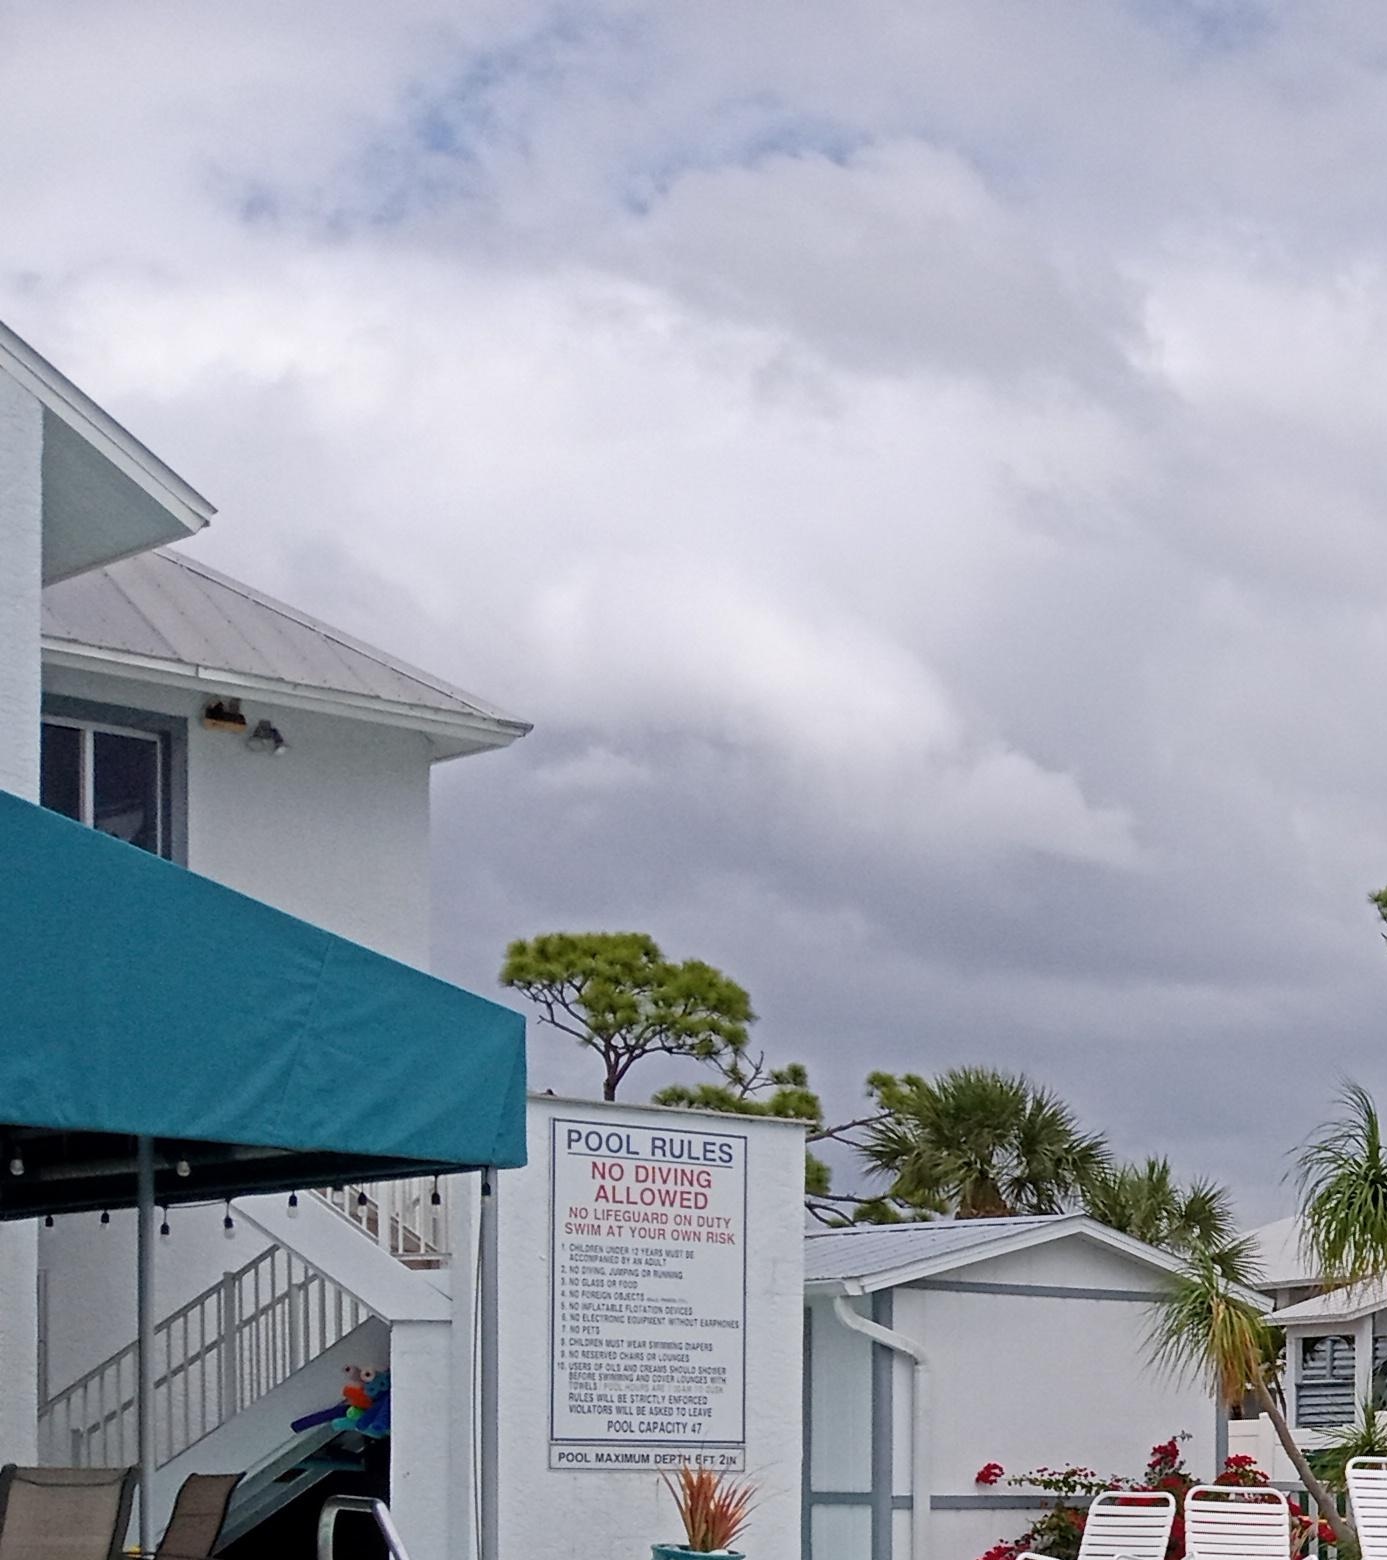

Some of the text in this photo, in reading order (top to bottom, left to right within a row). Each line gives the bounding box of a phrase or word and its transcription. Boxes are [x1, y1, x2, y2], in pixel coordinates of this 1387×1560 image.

[568, 1129, 733, 1163] POOL RULES
[592, 1161, 712, 1188] NO DIVING
[595, 1185, 708, 1210] ALLOWED
[569, 1207, 731, 1228] NO LIFEGUARD ON DUTY
[565, 1223, 735, 1244] SWIM AT YOUR OWN RISK
[569, 1244, 603, 1254] CHILDREN
[606, 1246, 628, 1255] UNDER
[641, 1249, 663, 1257] YEARS
[665, 1250, 684, 1258] MUST
[686, 1251, 694, 1259] BE
[569, 1254, 619, 1264] ACCOMPANIED
[645, 1258, 666, 1266] ADULT
[569, 1266, 579, 1274] NO
[609, 1269, 639, 1277] JUMPING
[569, 1278, 579, 1286] NO
[581, 1279, 604, 1287] GLASS
[607, 1280, 616, 1288] OR
[581, 1291, 612, 1300] FOREIGN
[614, 1293, 645, 1301] OBJECTS
[581, 1303, 623, 1313] INFLATABLE
[625, 1305, 663, 1314] FLOTATION
[665, 1307, 692, 1315] DEVICES
[569, 1314, 579, 1322] NO
[582, 1314, 625, 1324] ELECTRONIC
[628, 1316, 666, 1325] EQUIPMENT
[668, 1318, 697, 1327] WITHOUT
[700, 1320, 739, 1329] EARPHONES
[583, 1326, 599, 1334] PETS
[569, 1338, 602, 1347] CHILDREN
[605, 1340, 624, 1348] MUST
[627, 1341, 646, 1349] WEAR
[649, 1341, 682, 1350] SWIMMING
[685, 1343, 712, 1351] DIAPERS
[581, 1351, 617, 1360] RESERVED
[620, 1352, 643, 1361] CHAIRS
[647, 1353, 656, 1361] OR
[659, 1354, 689, 1362] LOUNGES
[569, 1362, 591, 1371] USERS
[606, 1364, 620, 1372] OILS
[623, 1364, 637, 1372] AND
[640, 1365, 667, 1373] CREAMS
[670, 1366, 695, 1374] SHOULD
[698, 1367, 726, 1375] SHOWER
[569, 1372, 596, 1381] BEFORE
[599, 1373, 634, 1382] SWIMMING
[636, 1374, 649, 1383] AND
[652, 1375, 674, 1383] COVER
[677, 1376, 707, 1384] LOUNGES
[569, 1393, 707, 1405] RULES WILL BE STRICTLY ENFORCED
[569, 1405, 712, 1417] VIOLATORS WILL BE ASKED TO LEAVE
[607, 1421, 702, 1434] POOL CAPACITY 47
[559, 1453, 590, 1463] POOL
[595, 1454, 650, 1464] MAXIMUM
[654, 1455, 691, 1464] DEPTH
